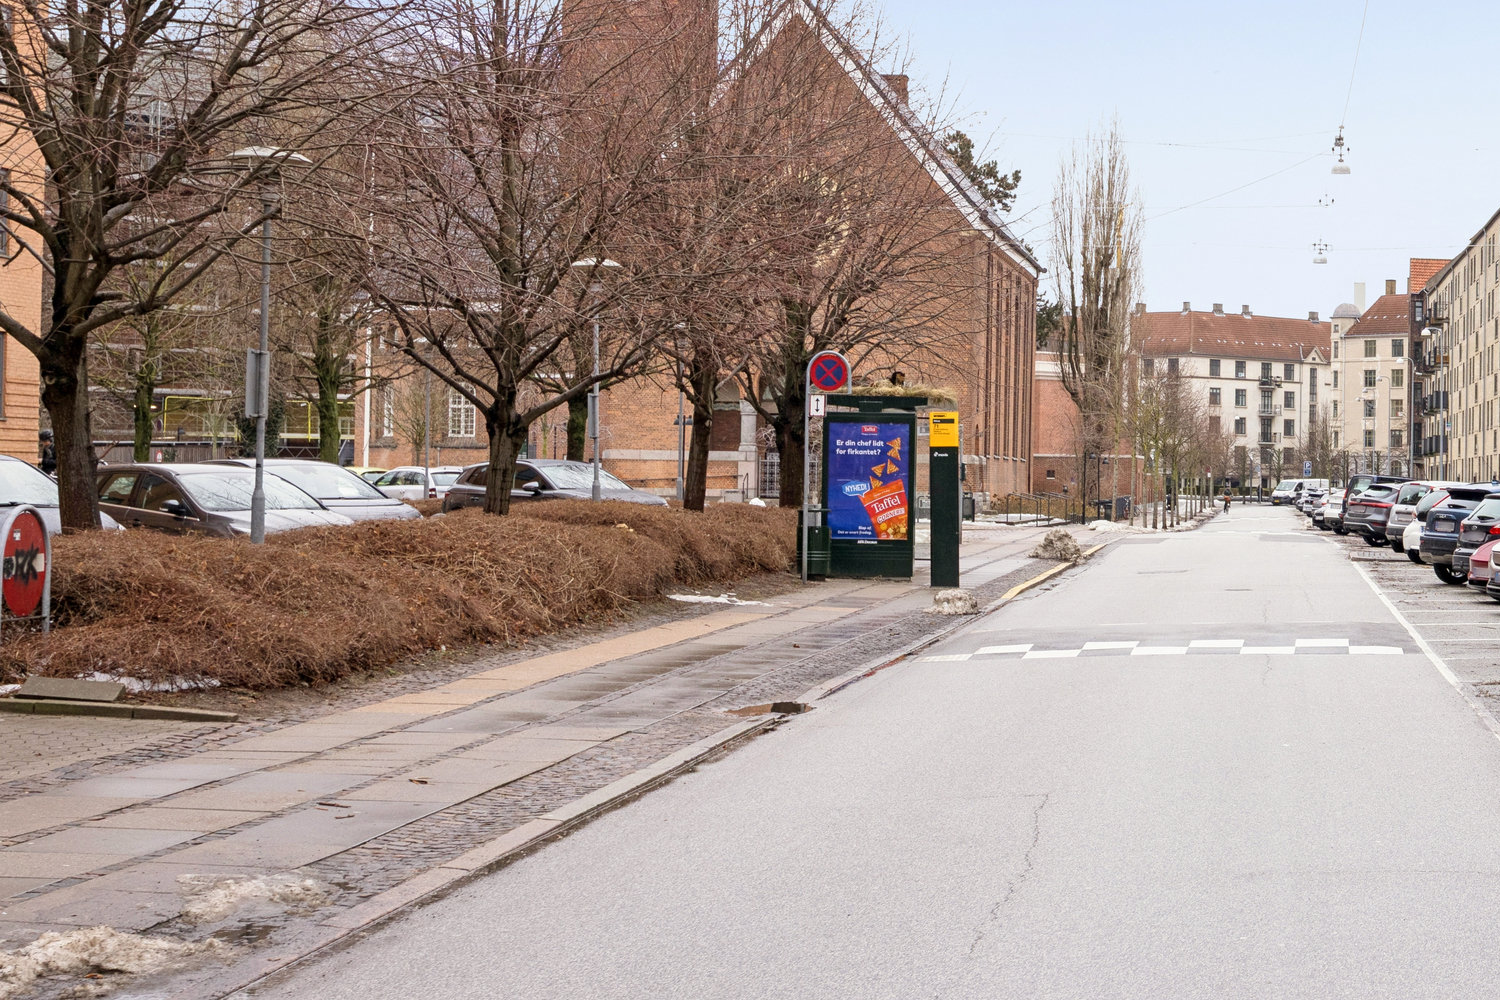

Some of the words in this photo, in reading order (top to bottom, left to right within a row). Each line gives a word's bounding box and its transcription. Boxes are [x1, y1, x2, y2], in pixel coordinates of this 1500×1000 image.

[857, 439, 871, 447] chef
[847, 448, 881, 456] firkantet?
[845, 484, 868, 494] NYHED!
[871, 495, 901, 514] Taffel
